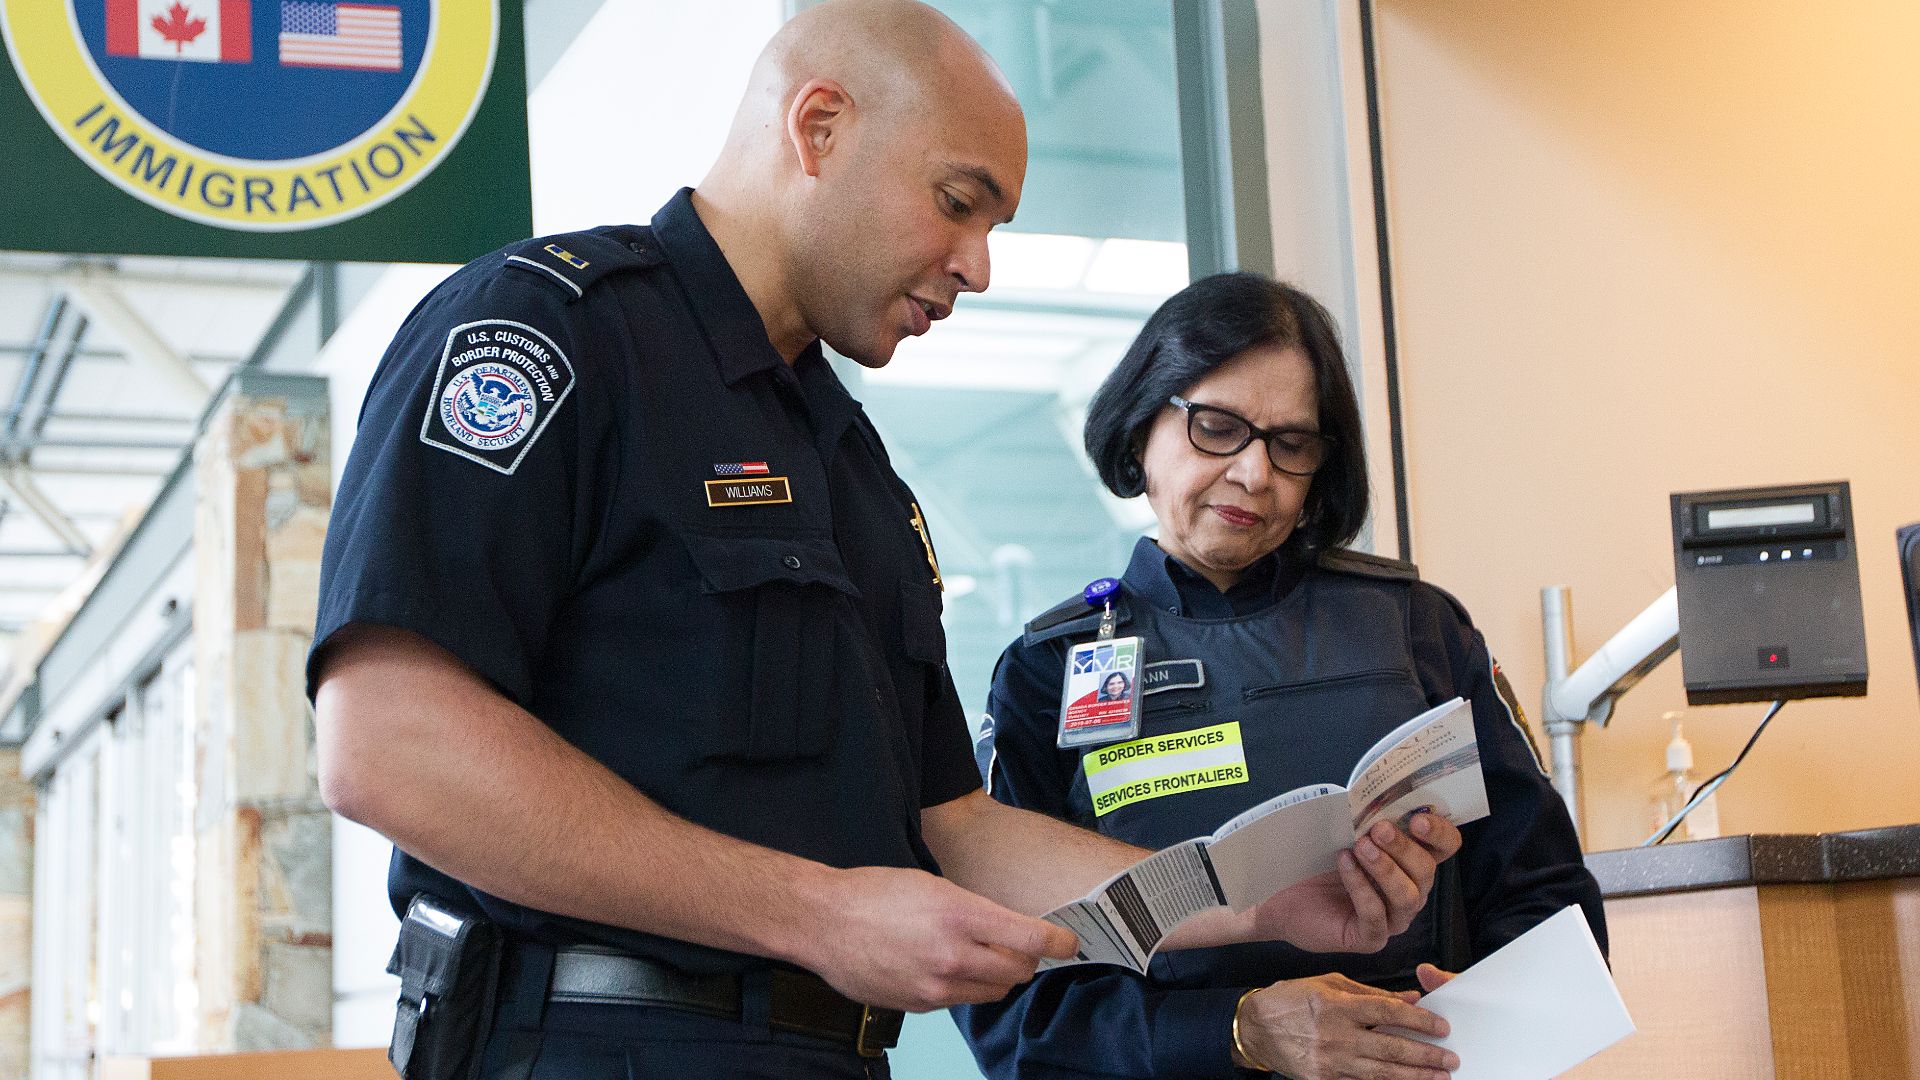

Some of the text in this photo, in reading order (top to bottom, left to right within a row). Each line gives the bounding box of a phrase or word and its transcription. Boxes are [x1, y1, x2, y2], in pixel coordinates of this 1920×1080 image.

[75, 102, 438, 215] IMMIGRATION
[451, 346, 555, 402] BORDER PROTECTION
[467, 330, 560, 380] U.S. CUSTOMS AND
[474, 366, 533, 402] DEPARTMENT
[523, 403, 533, 417] OF
[443, 397, 526, 447] HOMELAND SECURITY
[725, 484, 773, 498] WILLIAMS
[1074, 654, 1133, 675] YVR
[1099, 730, 1225, 767] BORDER SERVICES
[1096, 767, 1243, 811] SERVICES FRONTALIERS
